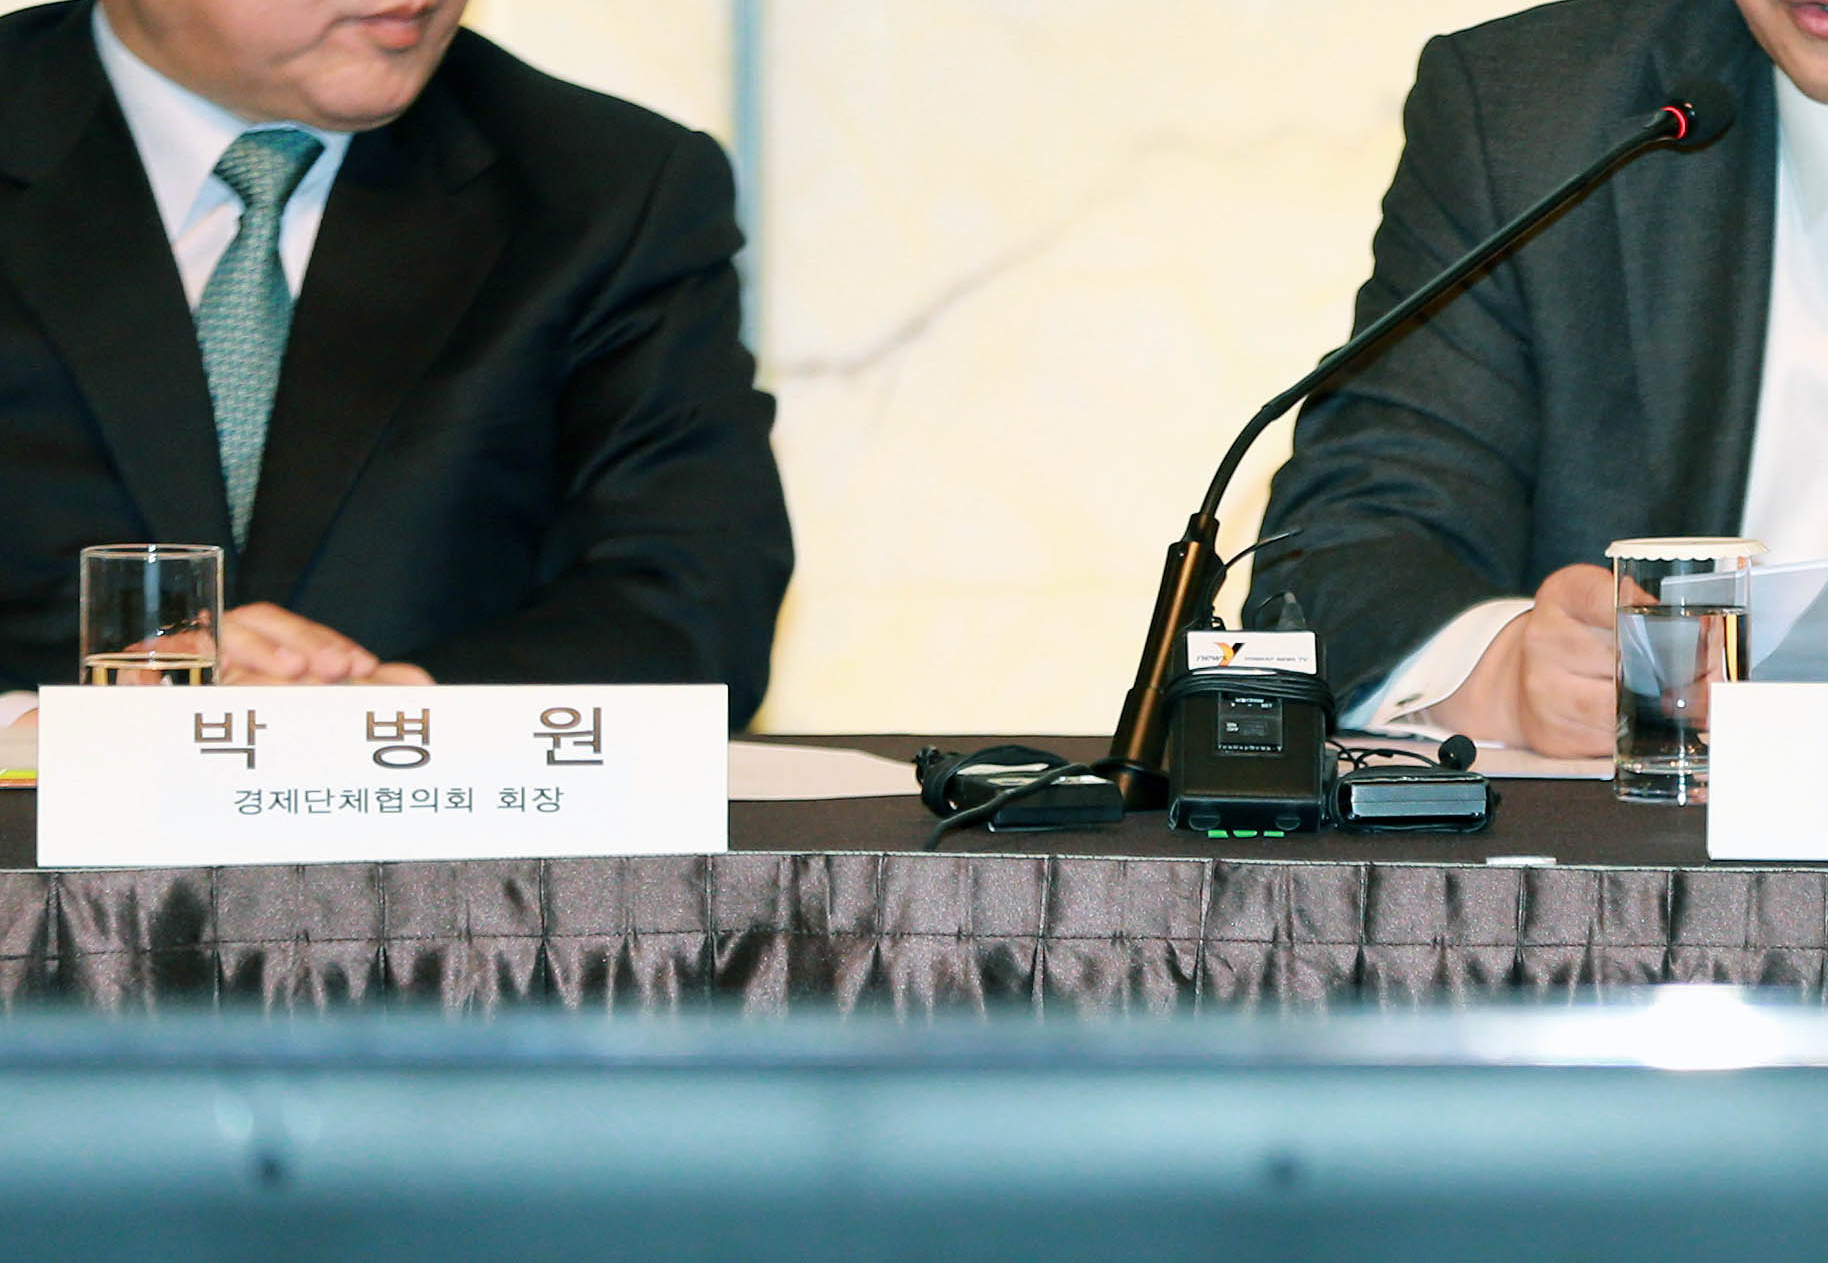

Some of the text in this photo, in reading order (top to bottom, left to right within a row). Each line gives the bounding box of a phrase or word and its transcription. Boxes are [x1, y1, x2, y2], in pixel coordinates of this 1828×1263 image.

[193, 706, 605, 771] 박 병 원
[233, 785, 565, 816] 경제단체협의회 회장
